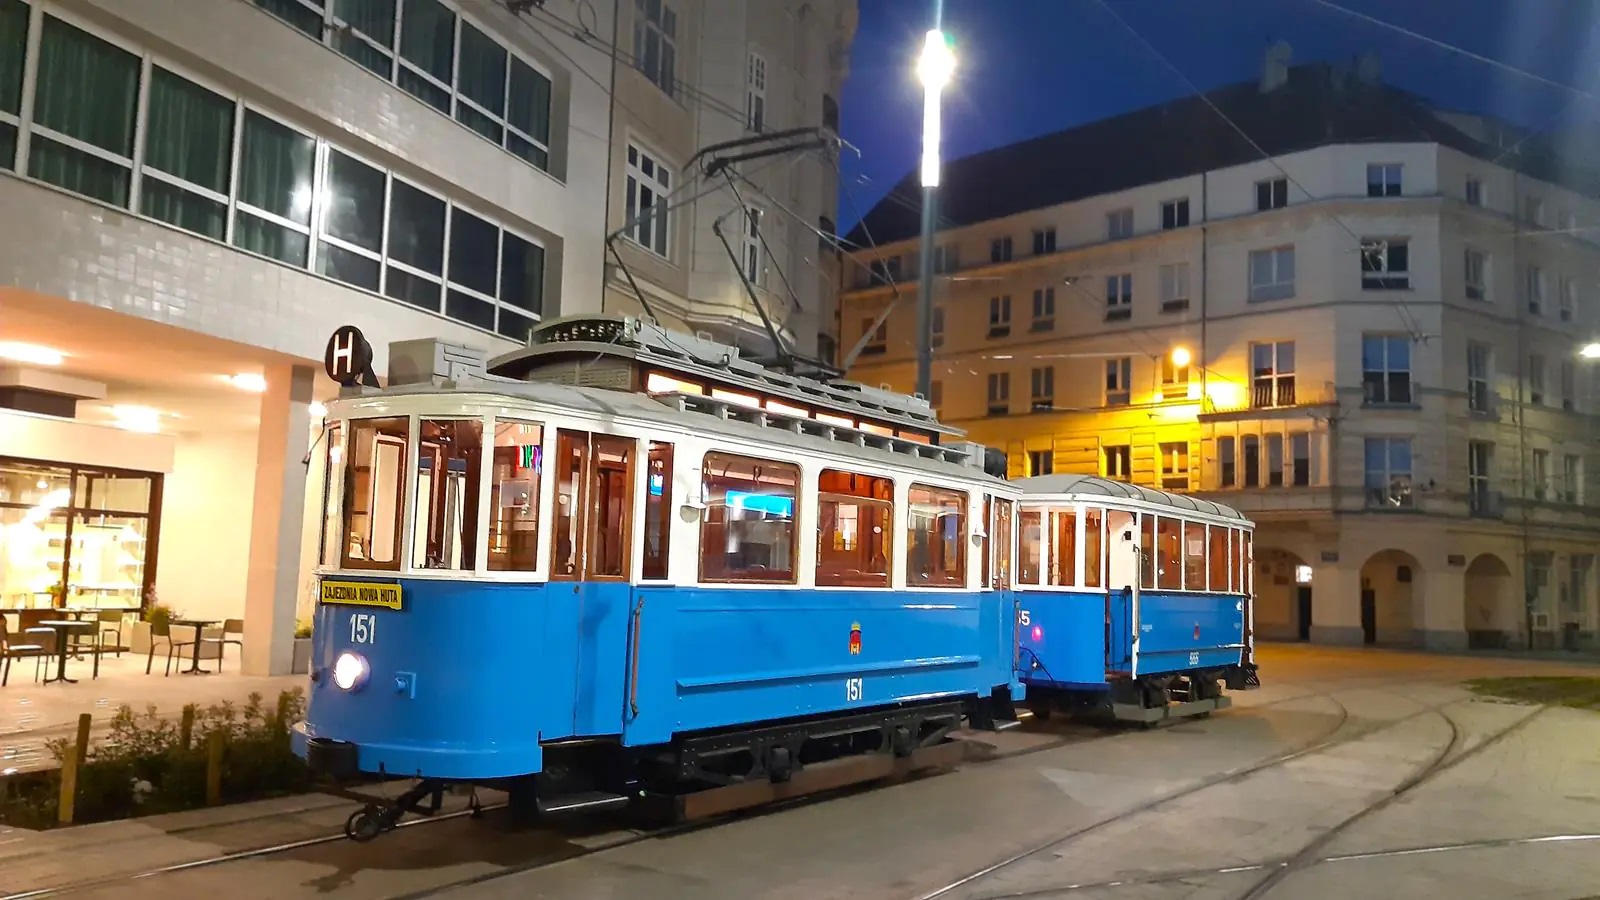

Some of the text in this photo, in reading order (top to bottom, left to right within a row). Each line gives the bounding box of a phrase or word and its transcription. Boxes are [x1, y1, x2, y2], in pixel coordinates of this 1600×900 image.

[333, 332, 353, 375] H
[324, 586, 398, 603] ZAJEZDNIA NOWA HUTA
[349, 613, 376, 644] 151
[845, 678, 863, 701] 151
